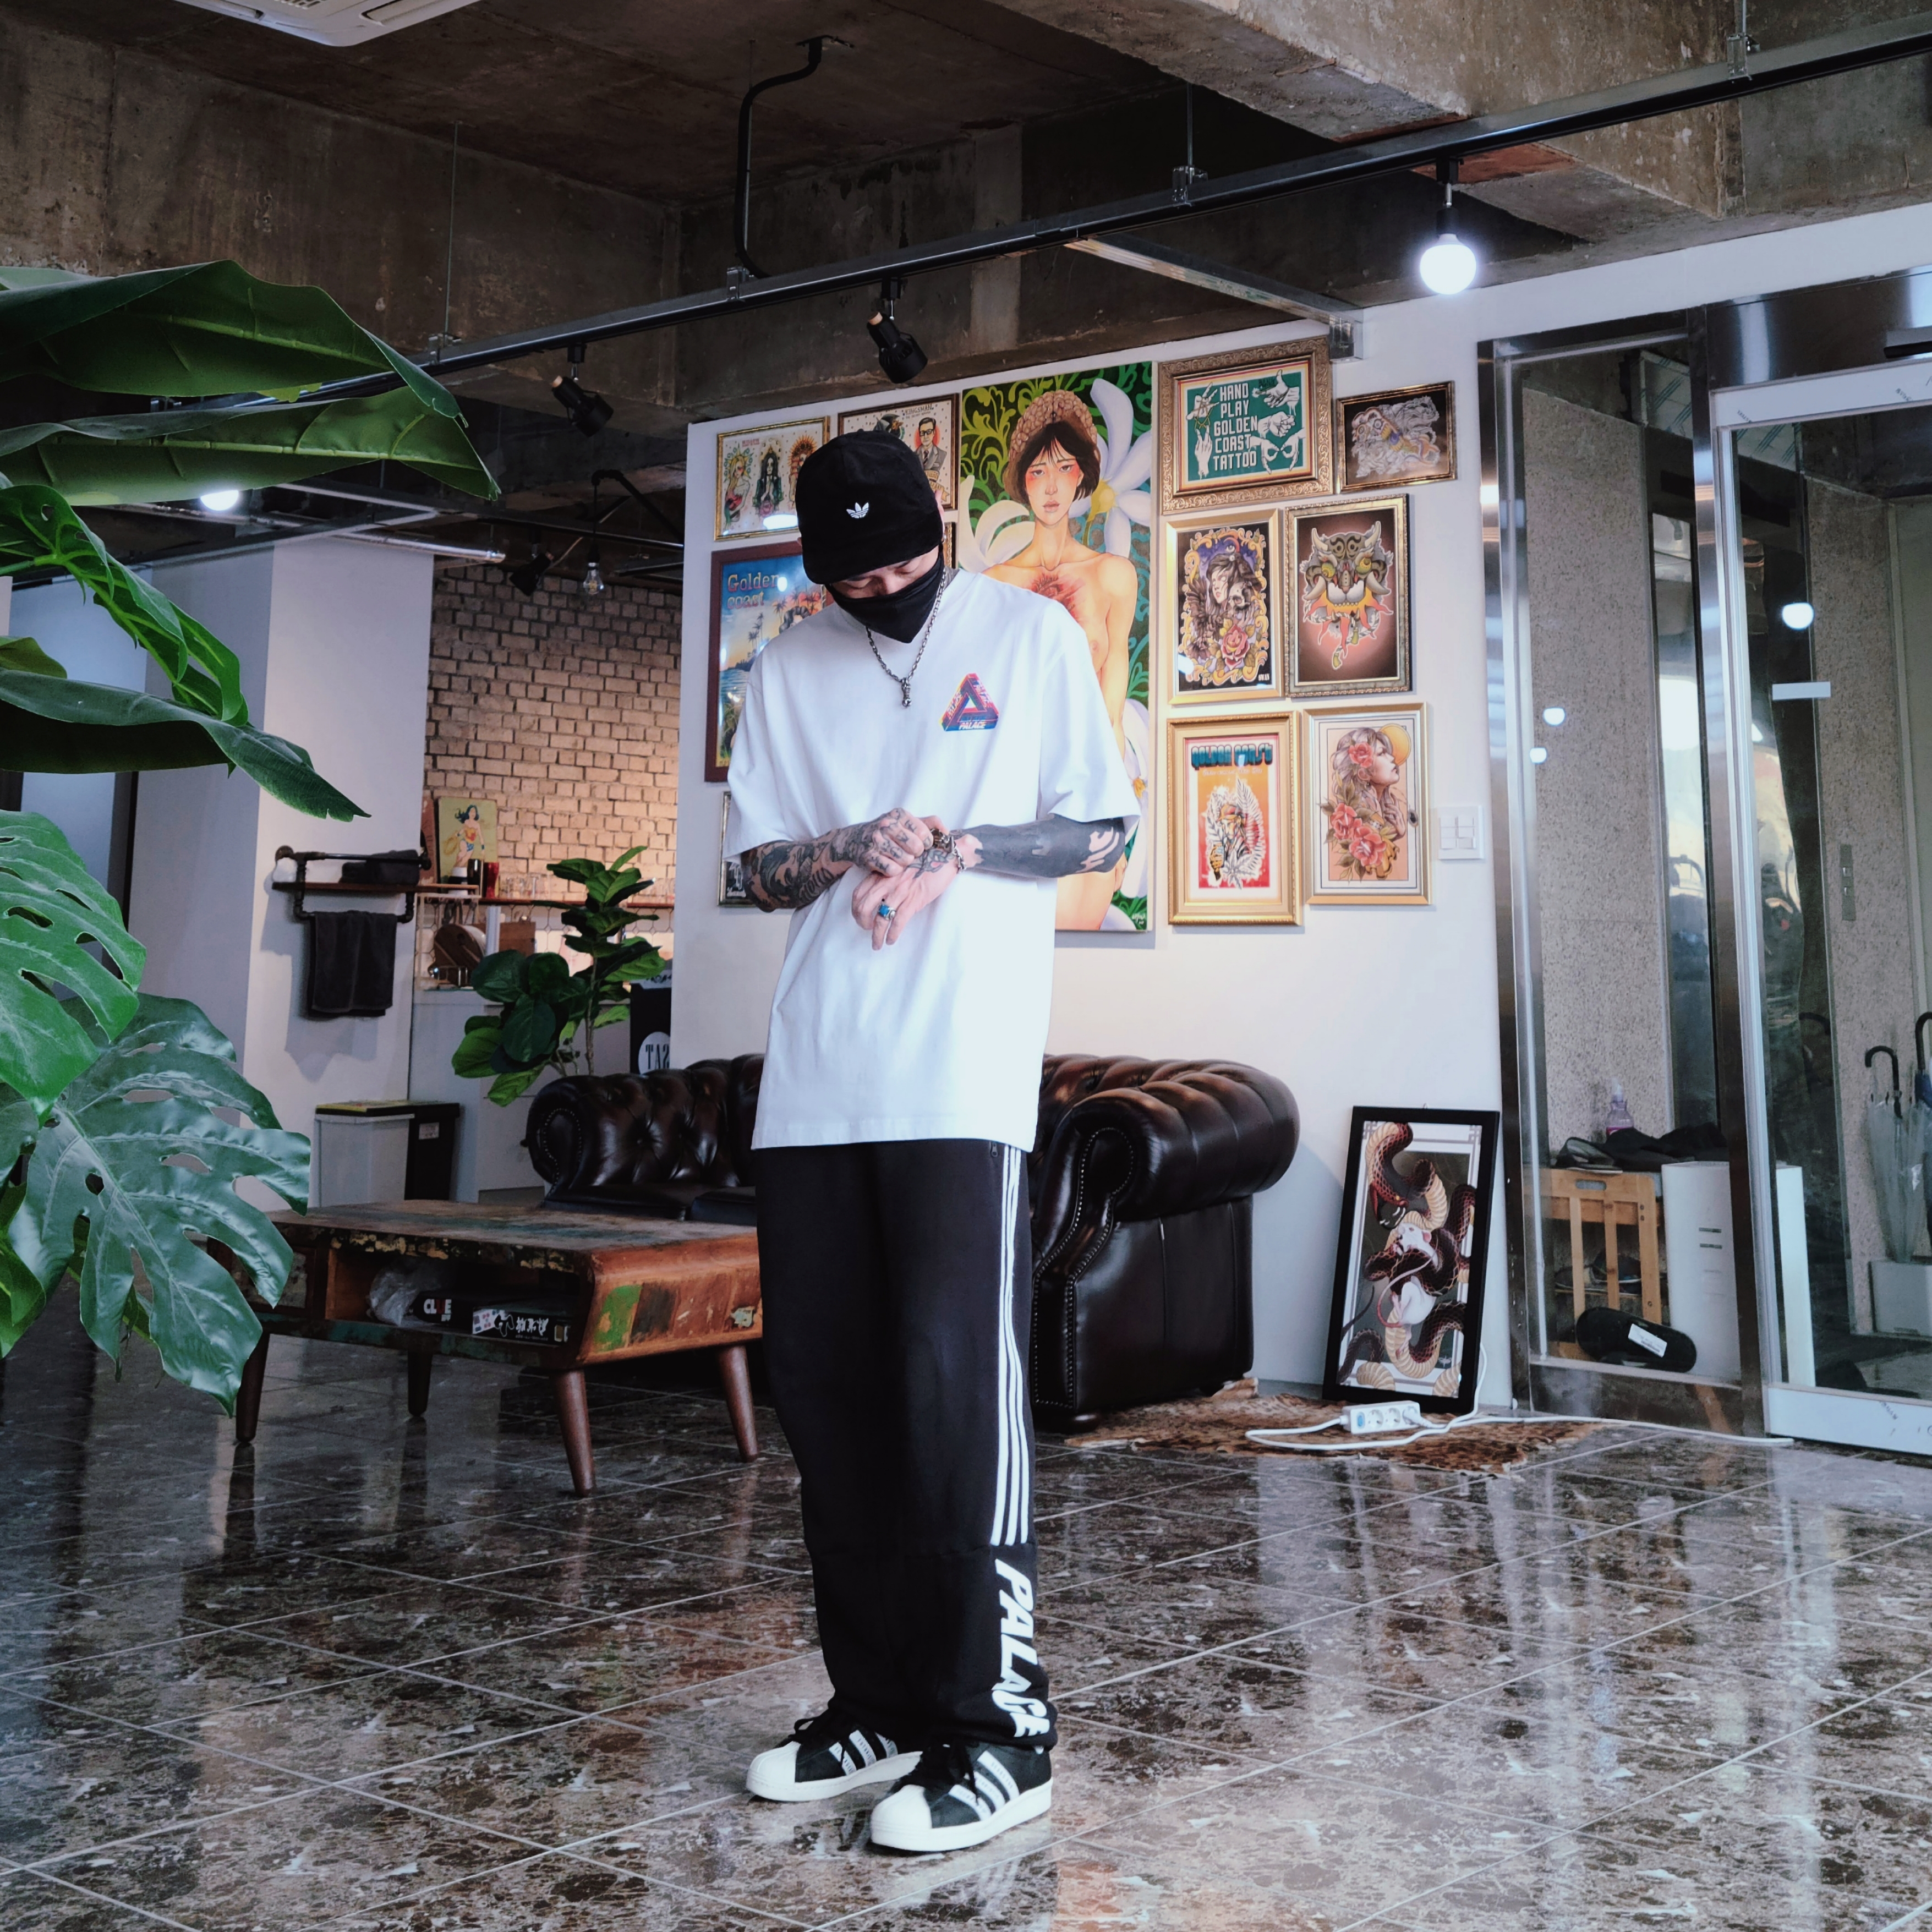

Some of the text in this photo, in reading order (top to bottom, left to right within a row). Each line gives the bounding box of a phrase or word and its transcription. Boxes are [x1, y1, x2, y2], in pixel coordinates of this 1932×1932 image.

[1219, 382, 1249, 402] HAND
[1220, 400, 1249, 419] PLAY
[1213, 415, 1258, 436] GOLDEN
[1215, 434, 1252, 453] COAST
[1213, 451, 1257, 471] TATTOO
[727, 590, 764, 610] coast
[959, 721, 987, 730] PALACE
[423, 1299, 452, 1314] CLUE
[991, 1558, 1050, 1737] PALACE
